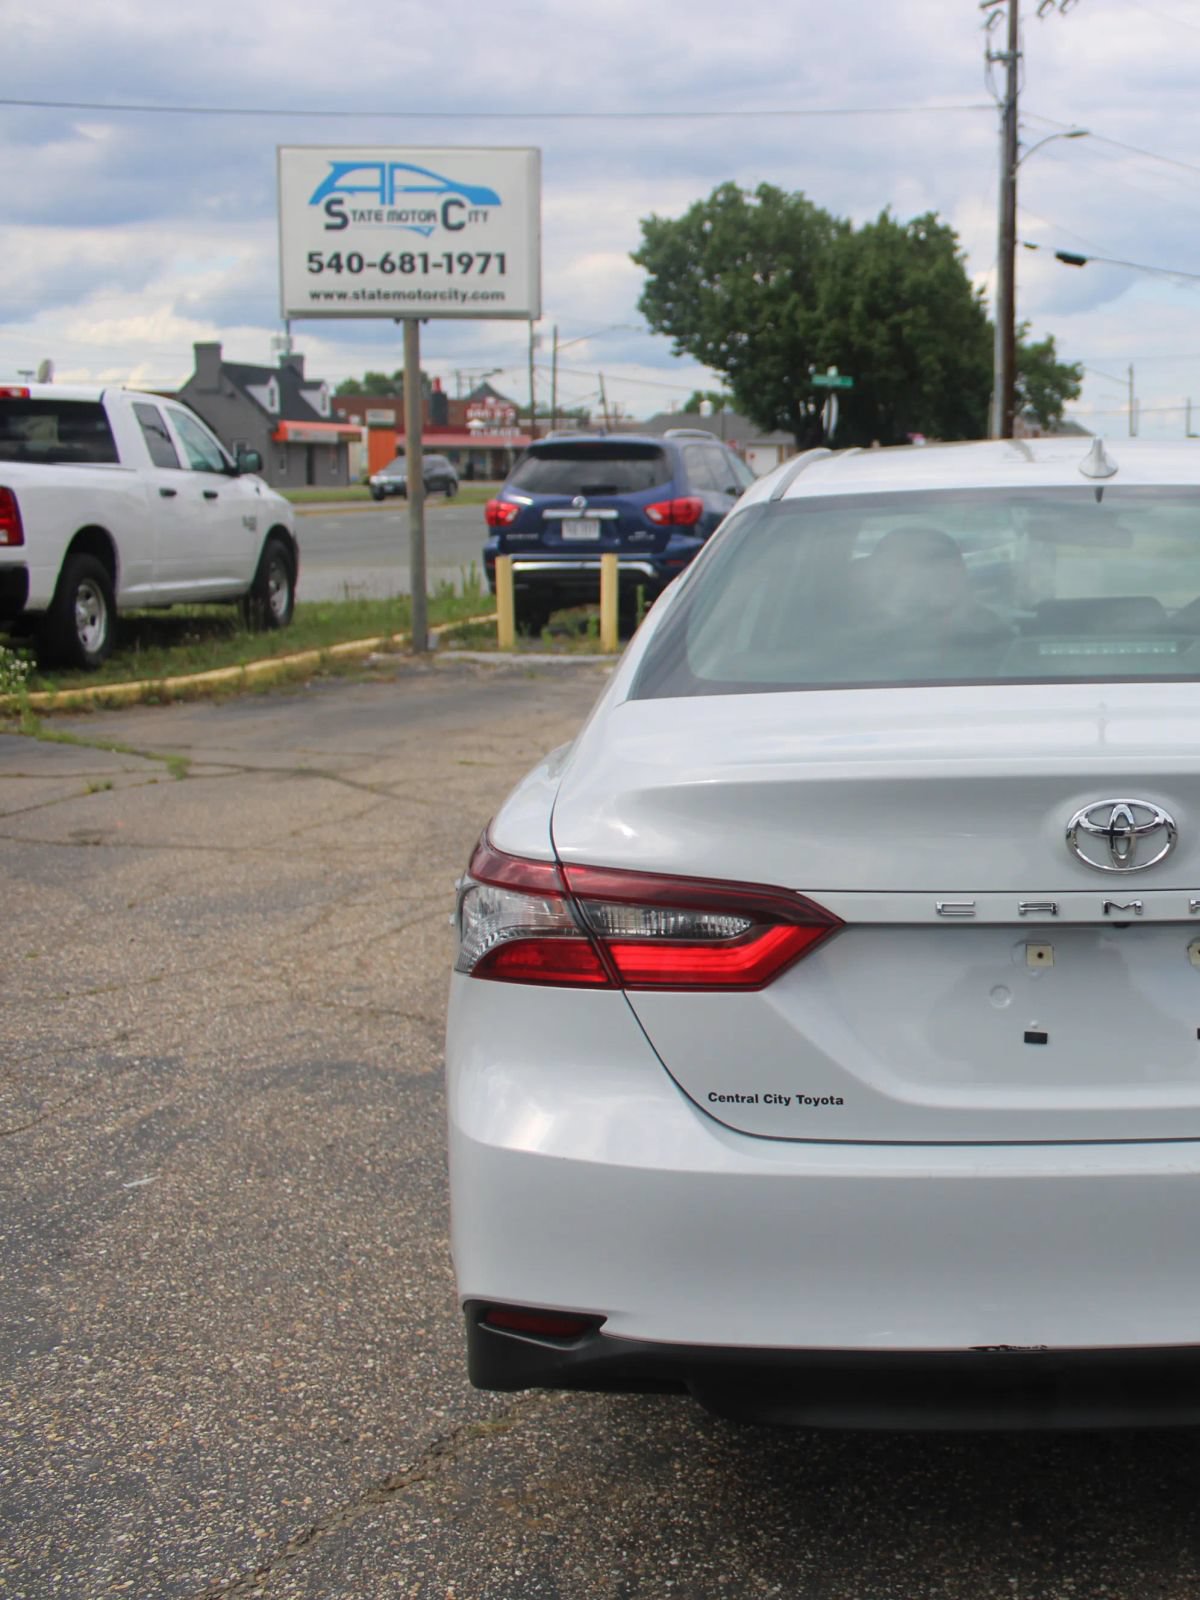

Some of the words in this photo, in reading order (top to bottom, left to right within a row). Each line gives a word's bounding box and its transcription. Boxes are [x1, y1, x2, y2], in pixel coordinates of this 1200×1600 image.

[323, 197, 384, 231] STATE
[386, 209, 438, 223] MOTOR
[441, 198, 490, 231] CITY
[307, 251, 506, 275] 540-681-1971
[308, 287, 506, 303] www.statemotorcity.com
[707, 1091, 759, 1104] Central
[763, 1093, 792, 1106] City
[795, 1094, 844, 1107] Toyota
